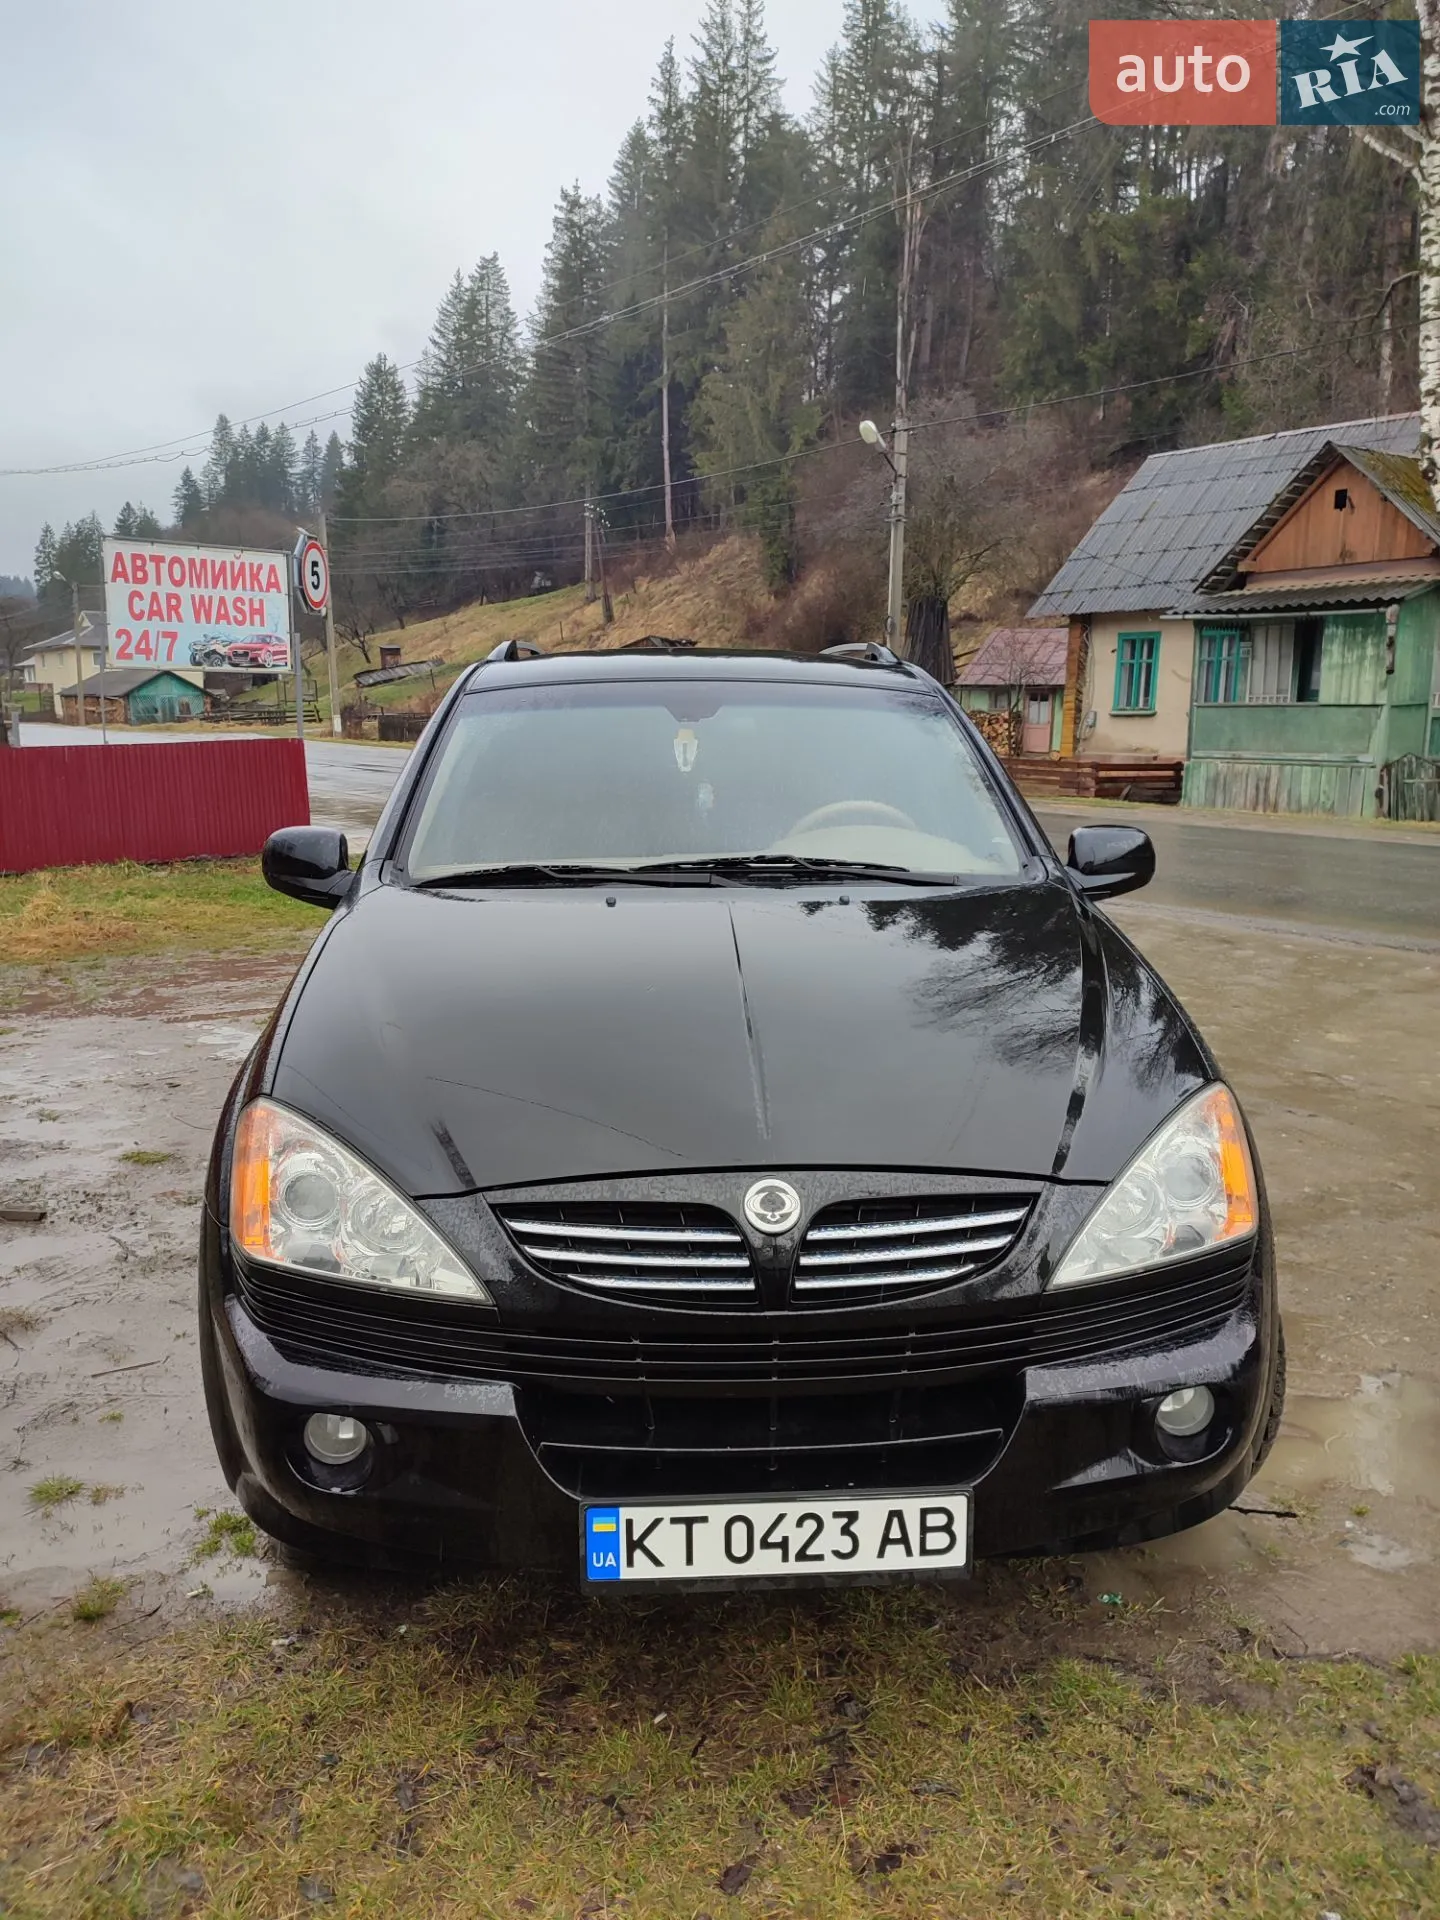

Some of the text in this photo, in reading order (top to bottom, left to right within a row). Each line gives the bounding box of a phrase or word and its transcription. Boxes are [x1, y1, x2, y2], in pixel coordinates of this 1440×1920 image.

[110, 551, 282, 594] АВТОМИЙКА
[310, 560, 321, 590] 5
[127, 589, 266, 628] CAR WASH
[115, 628, 179, 662] 24/7
[625, 1506, 957, 1568] KT 0423 AB
[592, 1552, 617, 1567] UA
